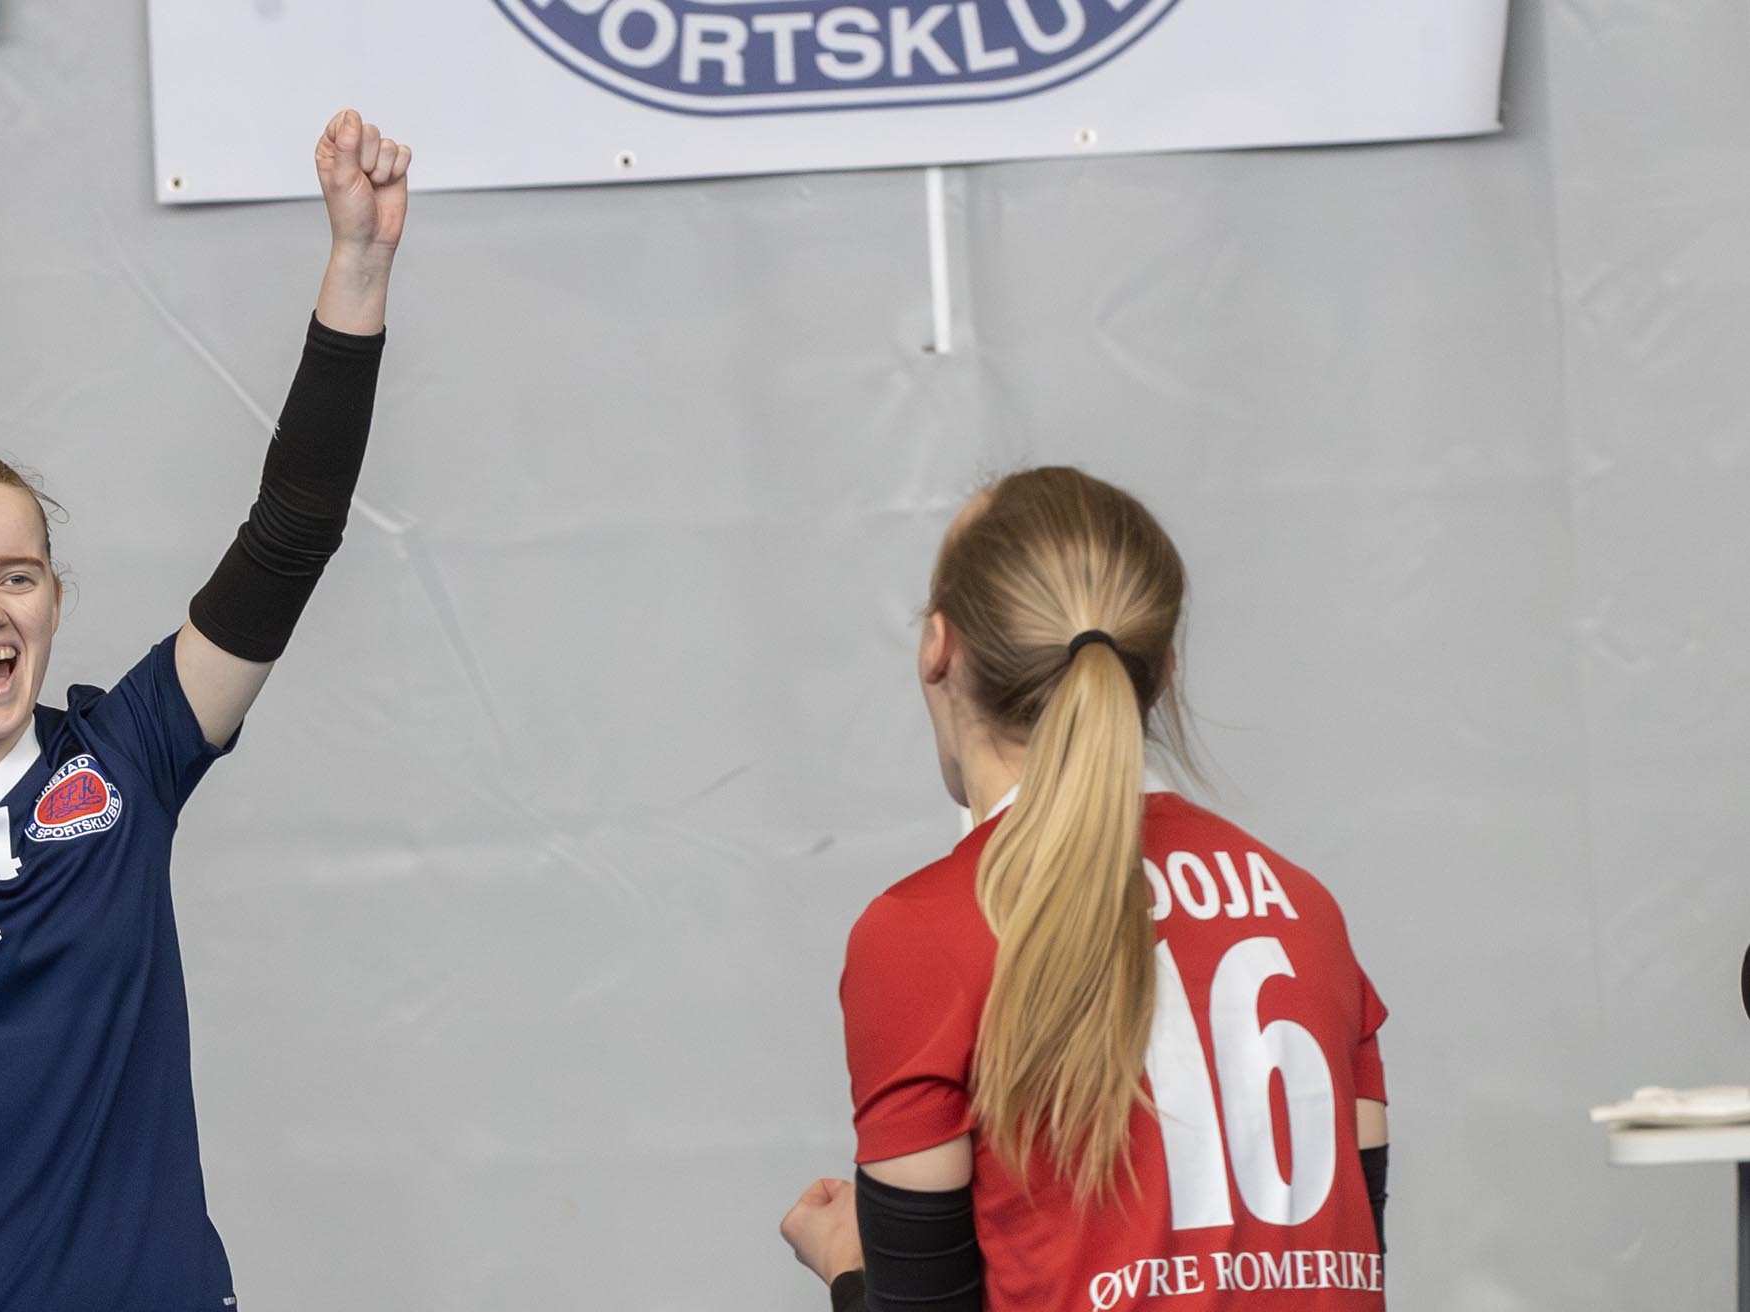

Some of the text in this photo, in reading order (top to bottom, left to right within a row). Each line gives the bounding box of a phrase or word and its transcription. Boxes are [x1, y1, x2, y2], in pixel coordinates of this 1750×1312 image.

[533, 0, 1130, 86] ORTSKLU
[36, 797, 120, 838] SPORTSKLUBB
[1146, 936, 1336, 1231] 16
[1209, 1251, 1383, 1292] ROMERIKE
